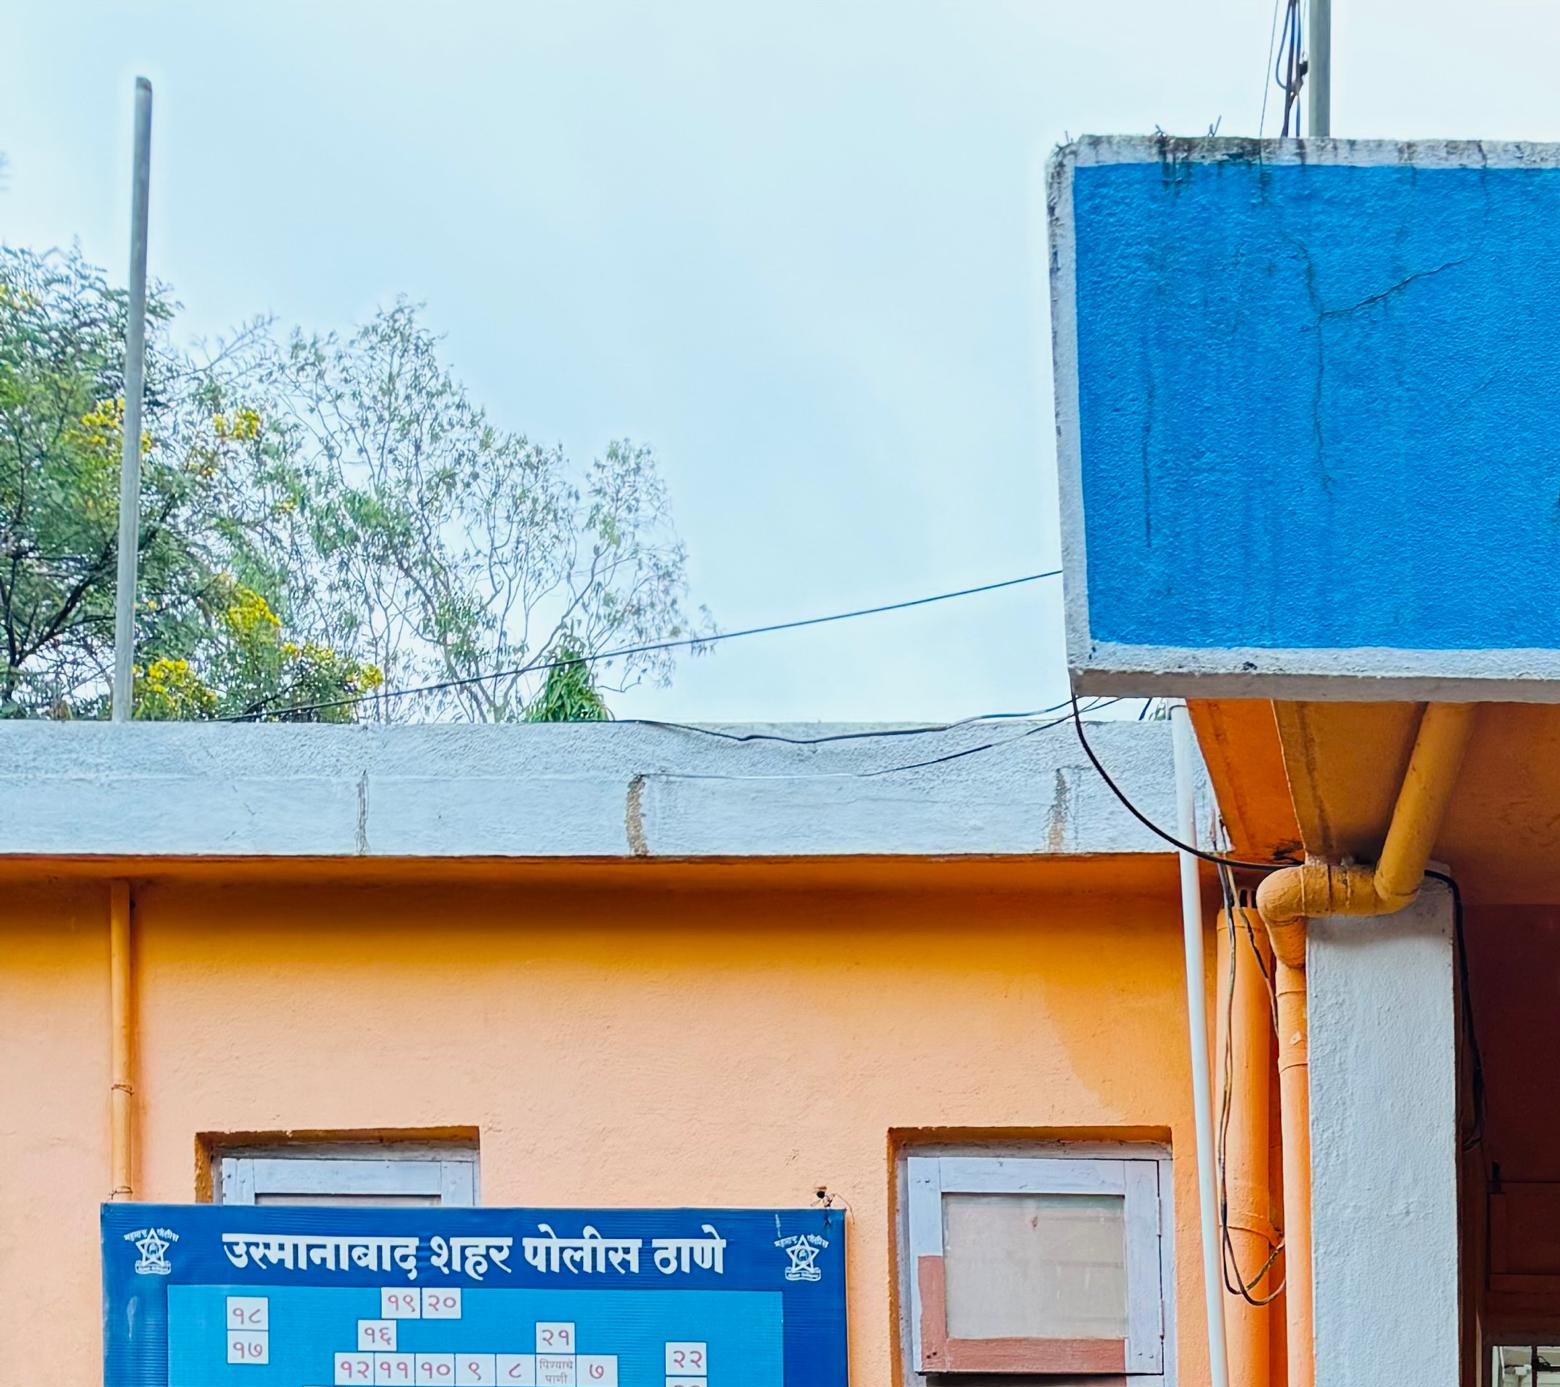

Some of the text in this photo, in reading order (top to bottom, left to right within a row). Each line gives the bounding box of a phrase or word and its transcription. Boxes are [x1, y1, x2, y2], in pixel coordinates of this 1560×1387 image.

[222, 1223, 726, 1280] उस्मानाबाद शहर पोलीस ठाणे
[388, 1294, 416, 1313] १९
[428, 1294, 456, 1312] २०
[232, 1307, 261, 1325] १८
[364, 1327, 391, 1346] १६
[541, 1329, 570, 1346] २१
[232, 1341, 263, 1359] १७
[673, 1350, 702, 1369] २२
[340, 1361, 370, 1379] १२
[379, 1361, 409, 1379] ११
[420, 1361, 450, 1379] १०
[468, 1361, 482, 1381] ९
[508, 1363, 522, 1379] ८
[589, 1363, 604, 1379] ७
